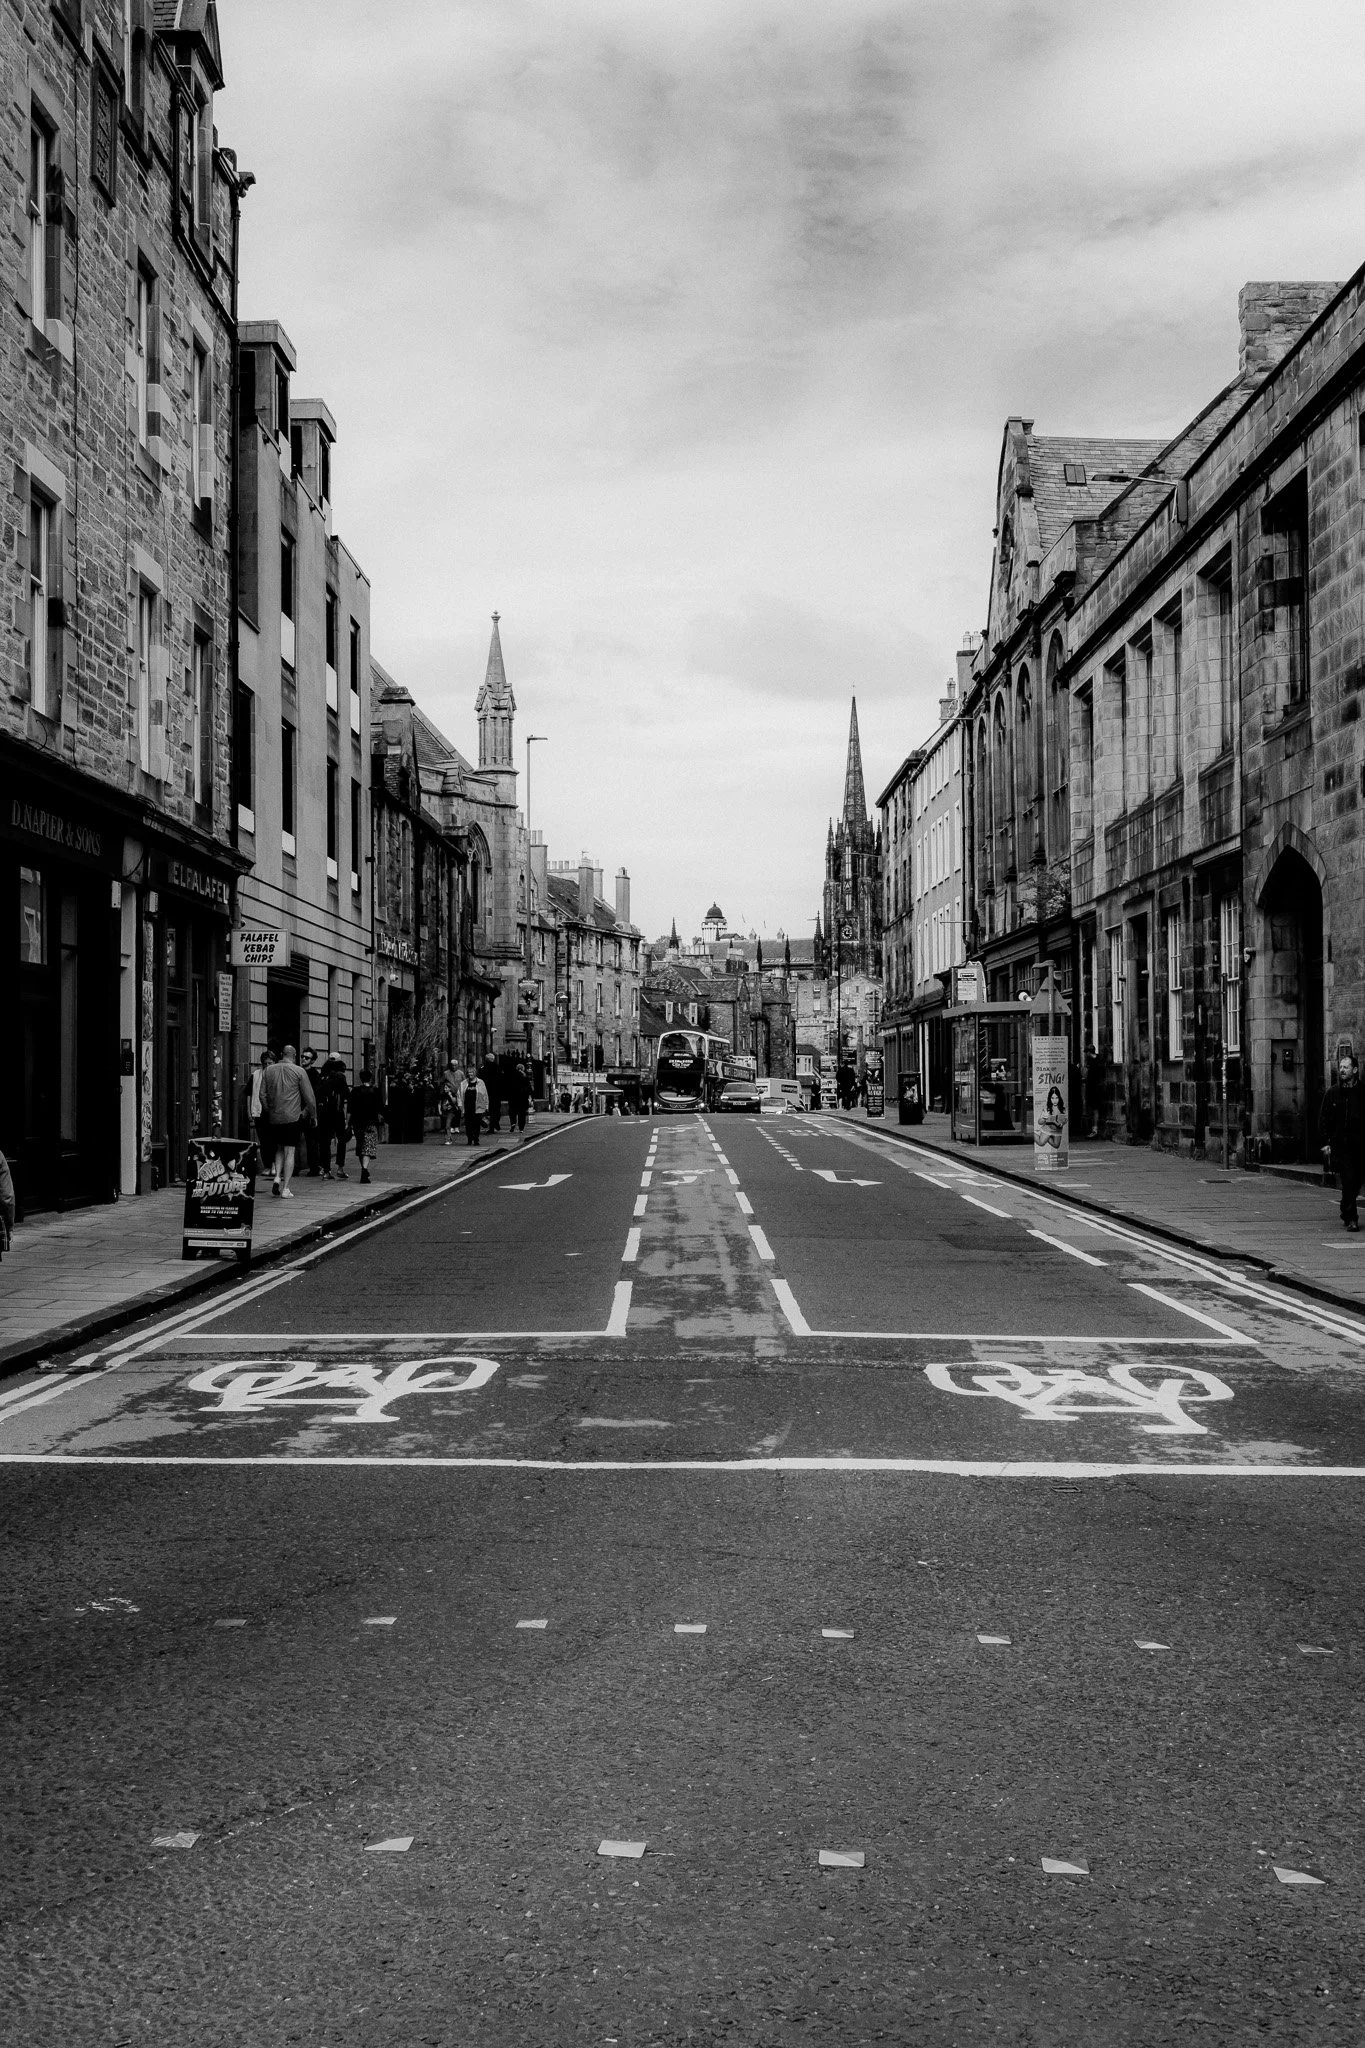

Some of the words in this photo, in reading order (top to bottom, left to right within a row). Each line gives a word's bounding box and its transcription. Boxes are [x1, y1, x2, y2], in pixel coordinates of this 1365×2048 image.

[65, 821, 74, 847] &
[75, 826, 103, 857] SONS
[240, 933, 279, 942] FALAFEL
[243, 944, 275, 953] KEBAB
[245, 954, 273, 963] CHIPS
[1038, 1072, 1065, 1085] SING!
[202, 1181, 247, 1197] FUTURE
